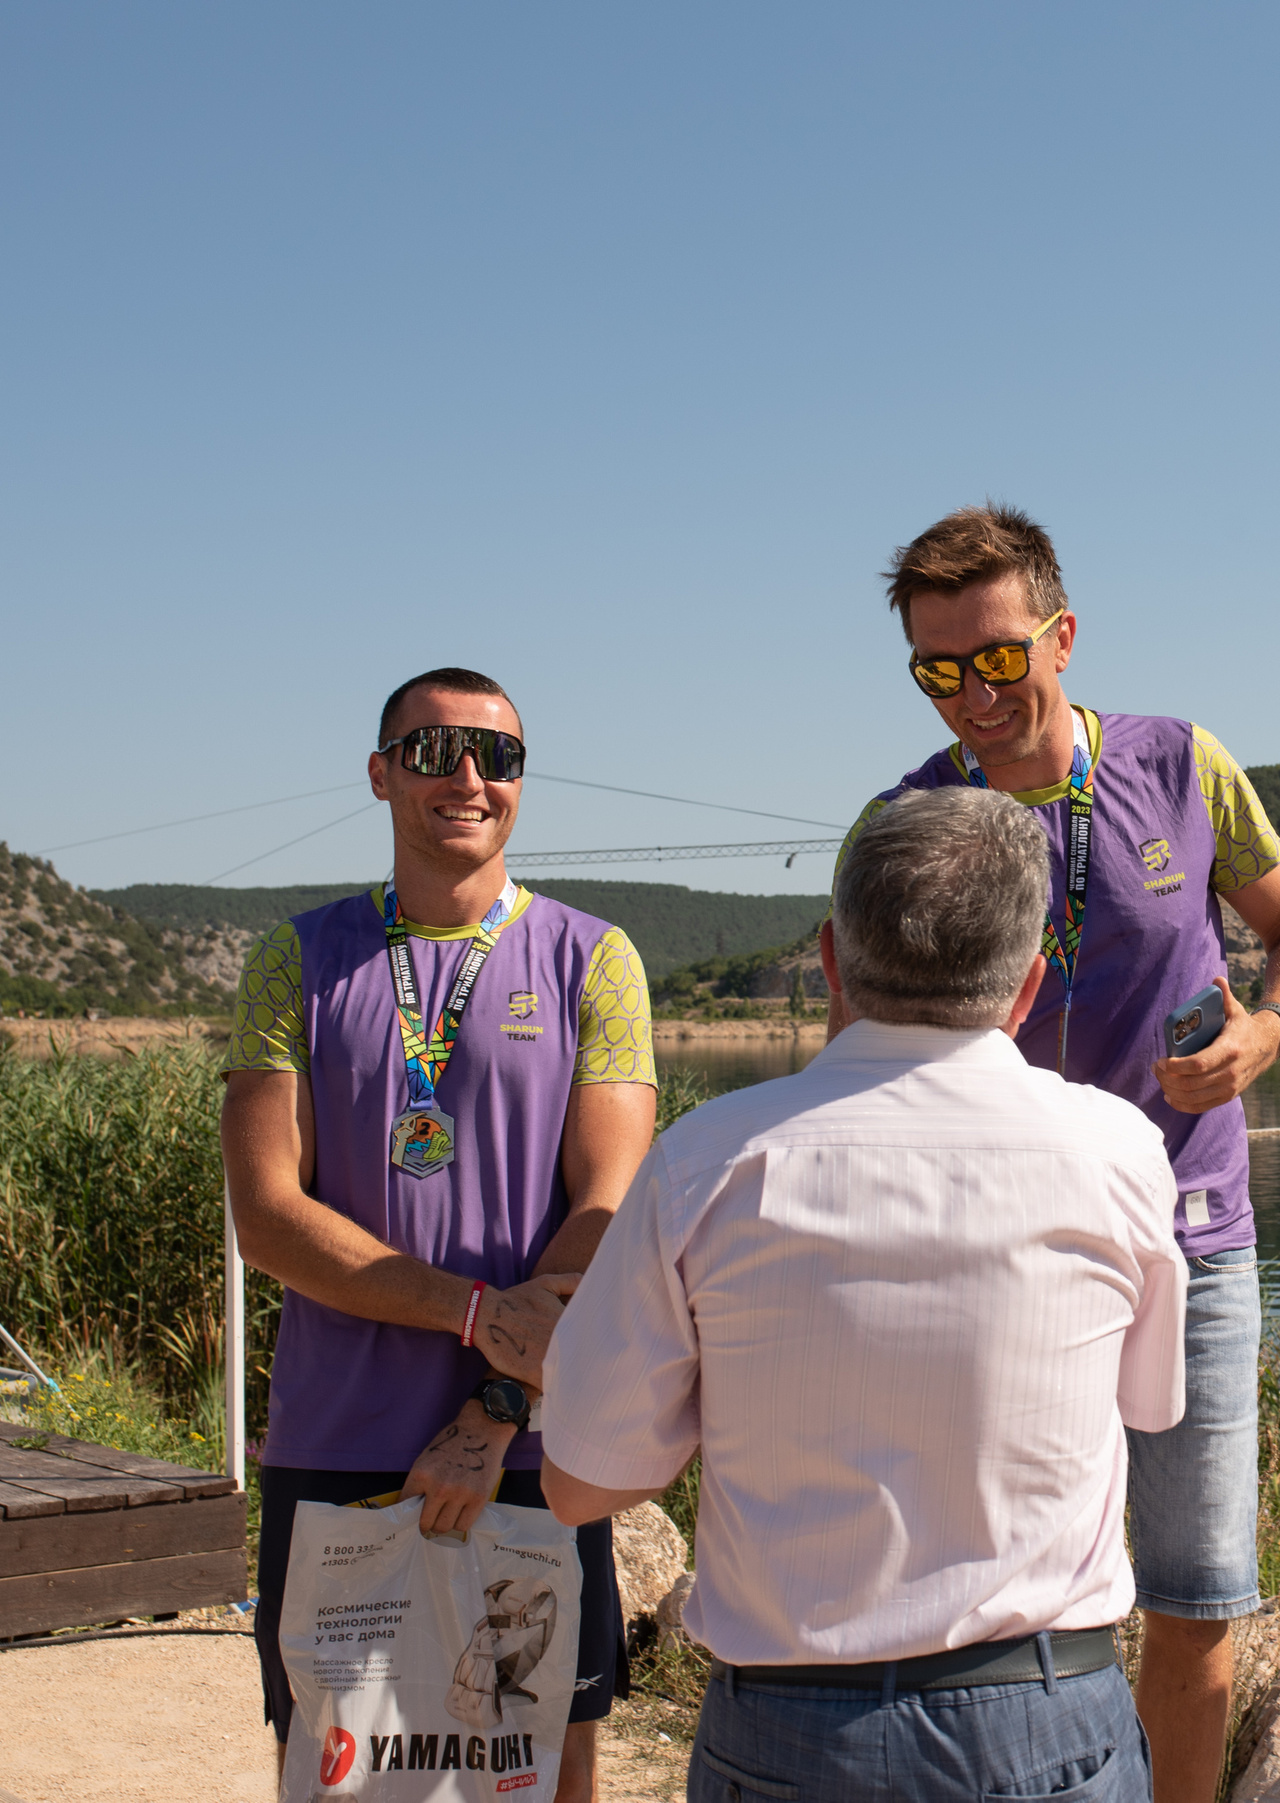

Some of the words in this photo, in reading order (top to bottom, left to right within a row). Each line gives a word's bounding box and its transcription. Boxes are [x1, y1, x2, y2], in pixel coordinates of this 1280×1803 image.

[1071, 805, 1091, 815] 2023
[1076, 816, 1091, 872] ТРИАТЛОНУ
[1069, 857, 1077, 891] ЧЕМПИОНАТ
[1143, 872, 1186, 890] SHARUN
[1075, 876, 1086, 891] ПО
[1153, 883, 1182, 897] TEAM
[472, 941, 490, 952] 2023
[397, 944, 413, 991] ТРИАТЛОНУ
[453, 998, 466, 1011] ПО
[460, 951, 487, 996] ТРИАТЛОНУ
[405, 992, 416, 1005] ПО
[500, 1024, 543, 1034] SHARUN
[507, 1033, 536, 1042] TEAM
[419, 1122, 430, 1135] 2
[323, 1546, 331, 1555] 8
[334, 1546, 354, 1555] 800
[493, 1543, 562, 1568] yamaguchi.ru
[318, 1600, 412, 1617] Космические
[316, 1615, 402, 1630] технологии
[315, 1635, 324, 1645] у
[328, 1632, 353, 1643] вас
[358, 1629, 395, 1643] дома
[313, 1659, 362, 1667] Массажное
